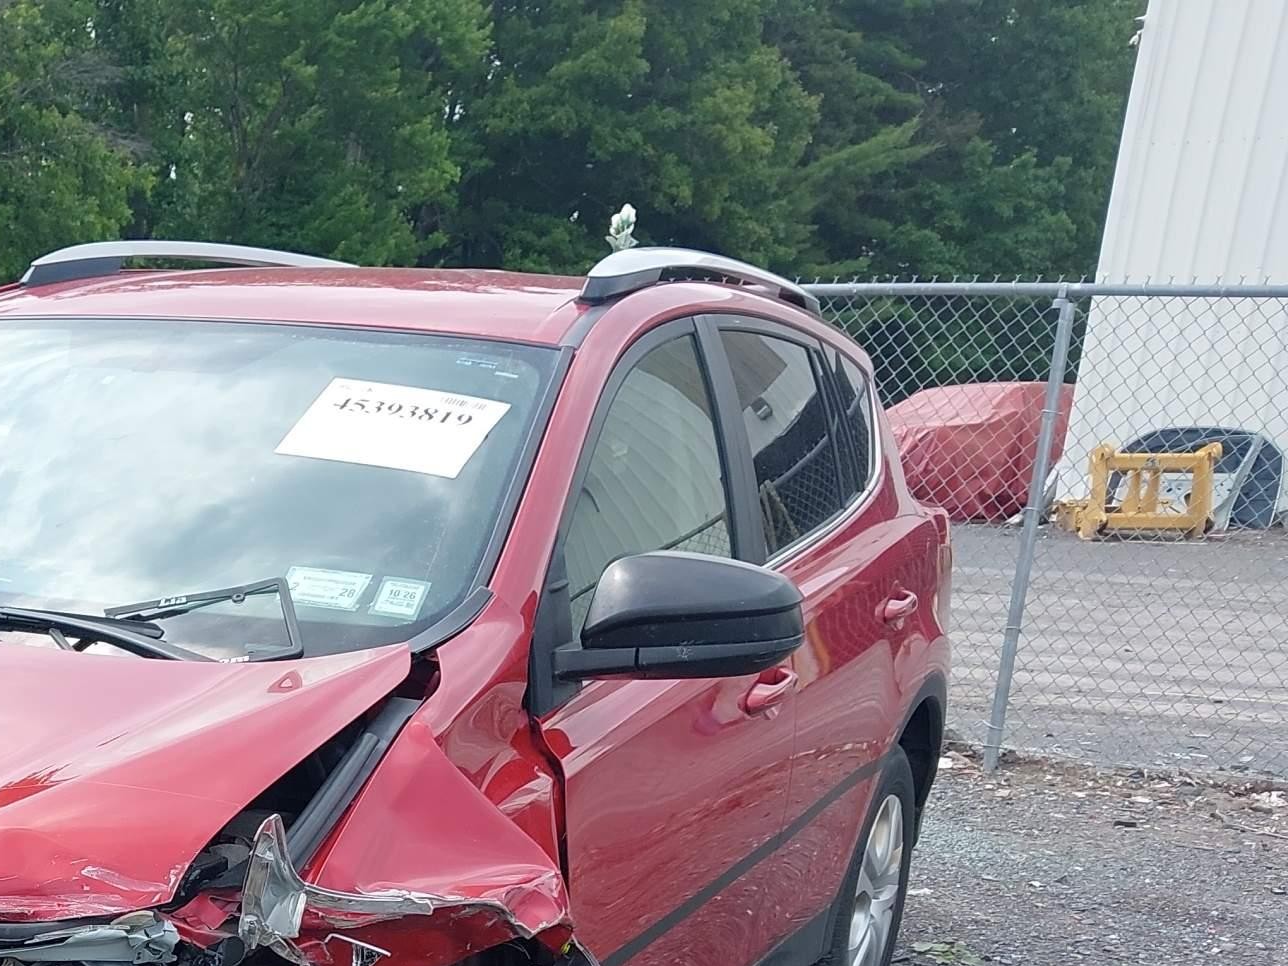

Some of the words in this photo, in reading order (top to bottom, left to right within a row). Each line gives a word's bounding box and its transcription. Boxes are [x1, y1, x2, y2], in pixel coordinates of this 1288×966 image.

[333, 397, 473, 425] 45393819
[338, 588, 356, 598] 28
[389, 589, 401, 598] 10
[403, 590, 417, 600] 26
